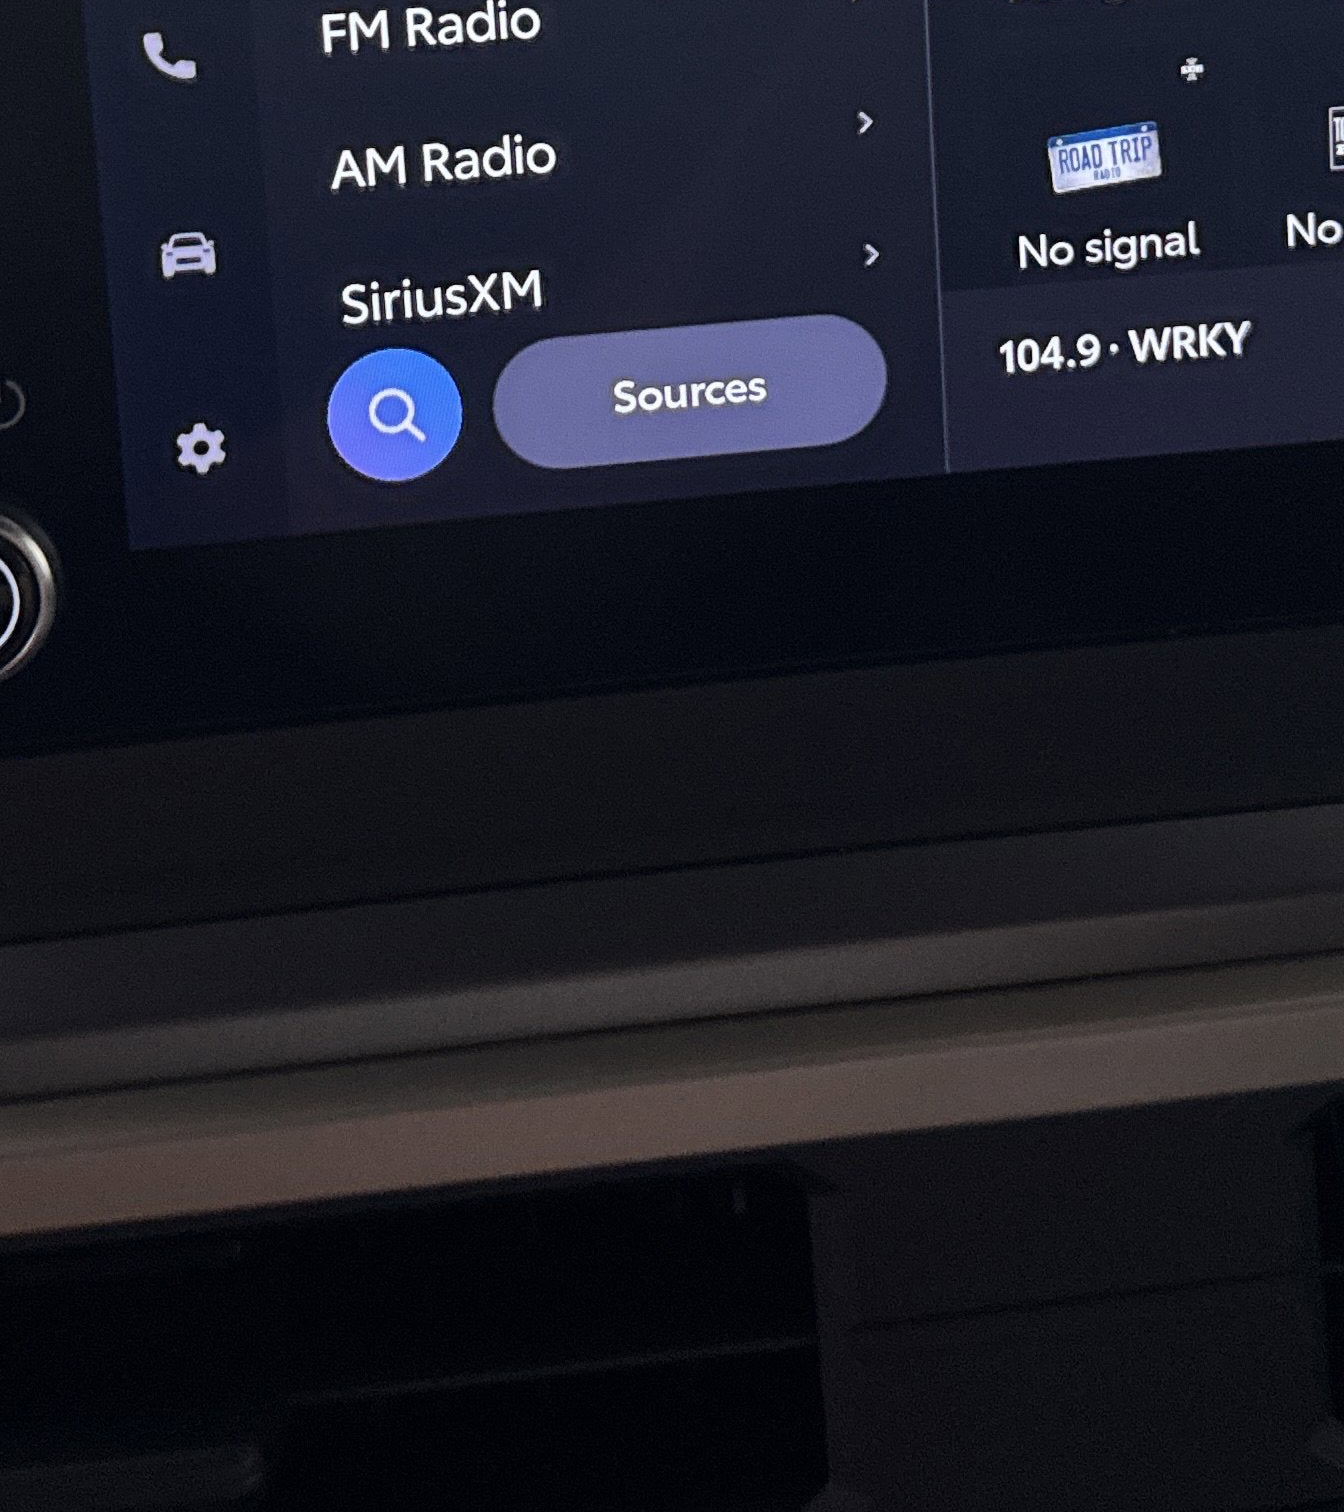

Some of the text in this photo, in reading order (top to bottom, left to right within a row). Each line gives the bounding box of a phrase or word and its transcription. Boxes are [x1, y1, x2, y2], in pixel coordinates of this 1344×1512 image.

[320, 8, 391, 55] FM
[329, 132, 558, 191] AM Radio
[1058, 135, 1152, 175] ROAD TRIP
[1092, 165, 1122, 181] RADIO
[1017, 219, 1202, 271] No signal
[1285, 210, 1344, 248] No
[340, 268, 544, 326] SiriusXM
[998, 332, 1102, 375] 104.9
[1126, 319, 1254, 364] WRKY
[612, 376, 768, 415] Sources
